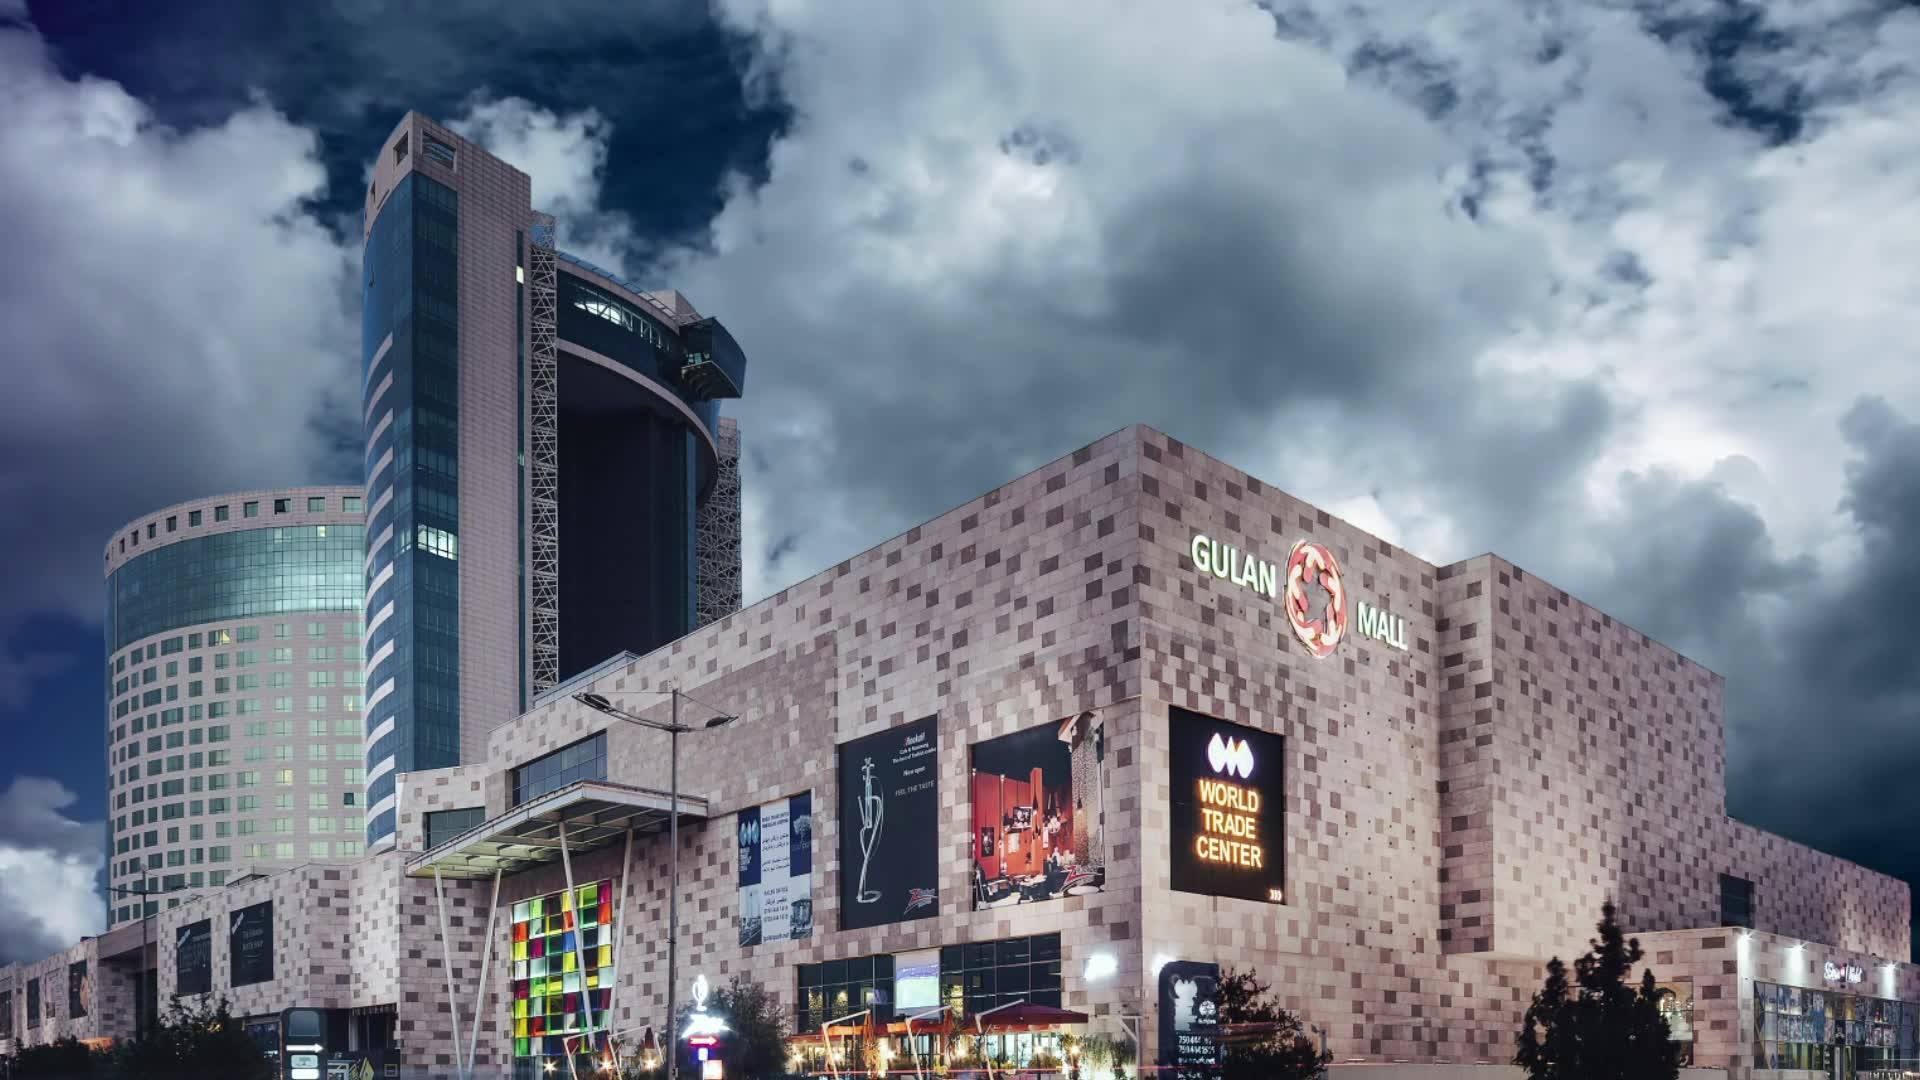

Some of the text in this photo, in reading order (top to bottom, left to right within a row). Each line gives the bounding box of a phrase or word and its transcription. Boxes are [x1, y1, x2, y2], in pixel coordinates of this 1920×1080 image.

[1191, 534, 1408, 650] GULAN MALL
[1199, 780, 1259, 813] WORLD
[1202, 808, 1256, 839] TRADE
[1196, 835, 1262, 868] CENTER
